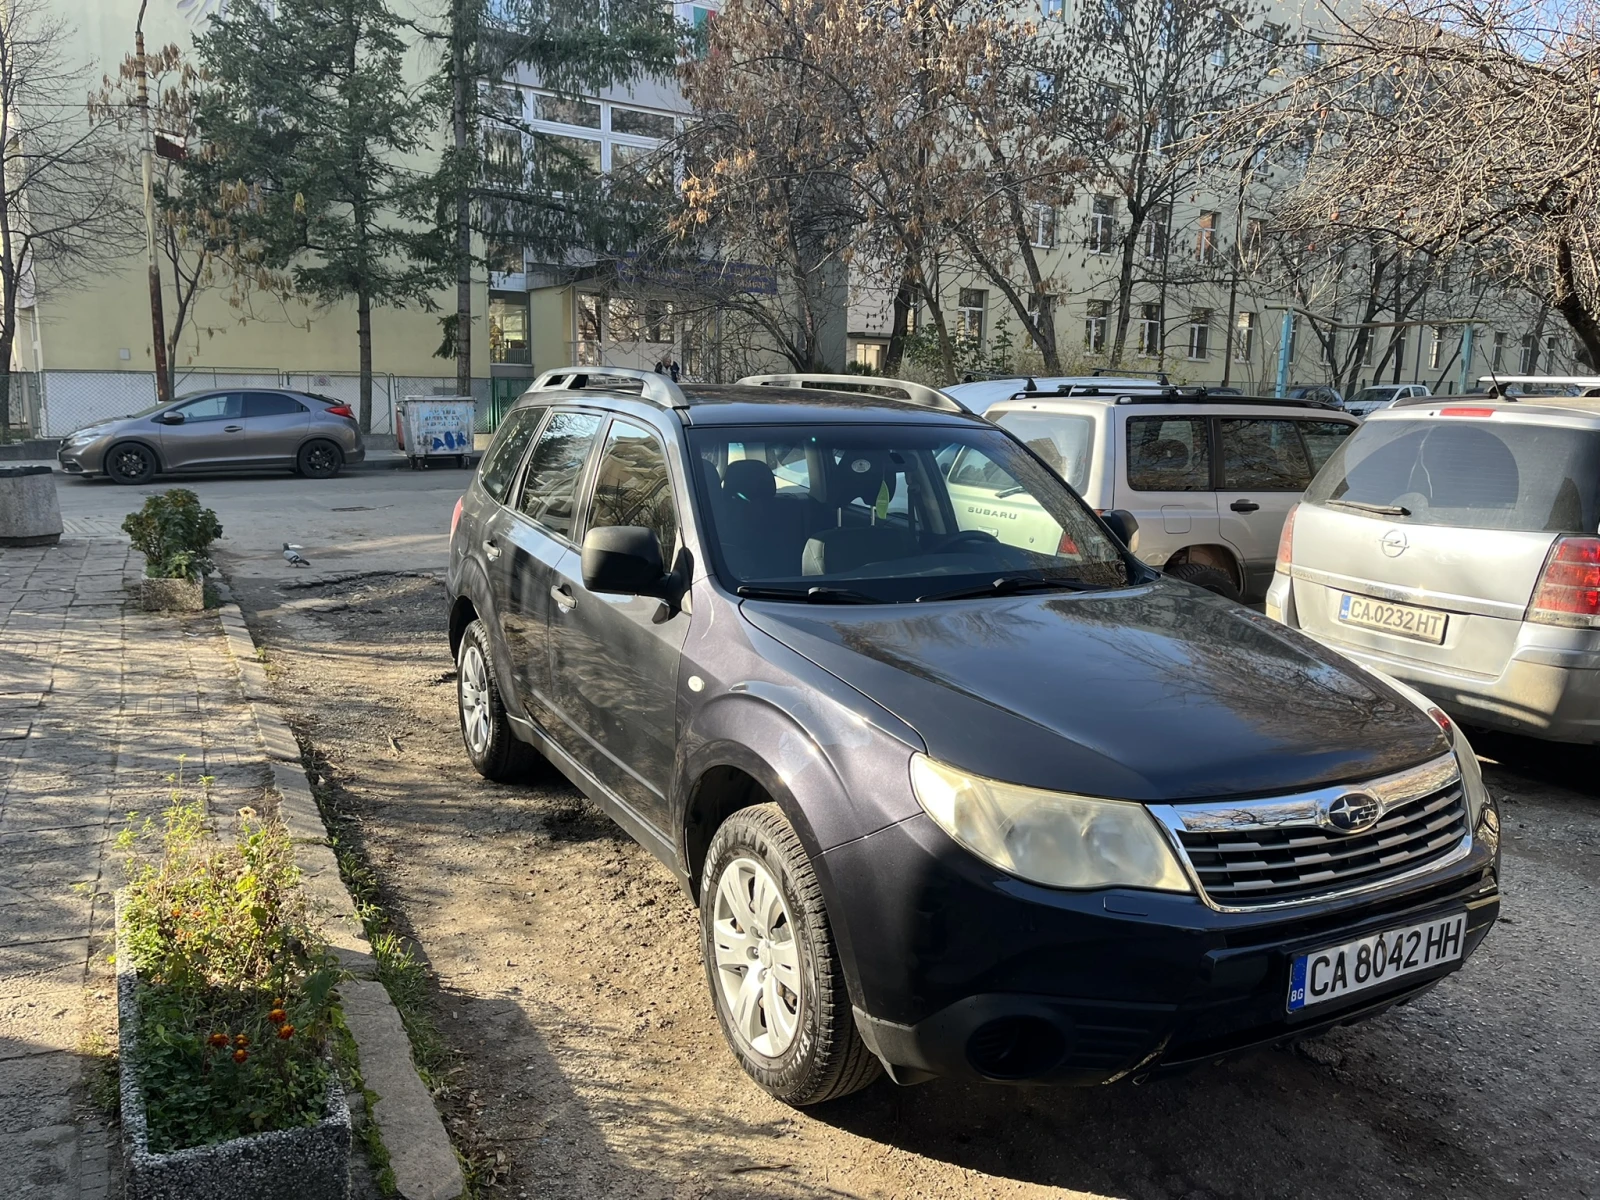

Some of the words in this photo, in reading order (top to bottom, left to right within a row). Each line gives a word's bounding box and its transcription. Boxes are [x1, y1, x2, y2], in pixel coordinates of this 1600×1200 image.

[967, 506, 1018, 520] SUBARU
[1310, 951, 1348, 996] CA
[1354, 930, 1422, 984] 8042
[1424, 918, 1463, 964] HH
[1290, 988, 1304, 1002] BG
